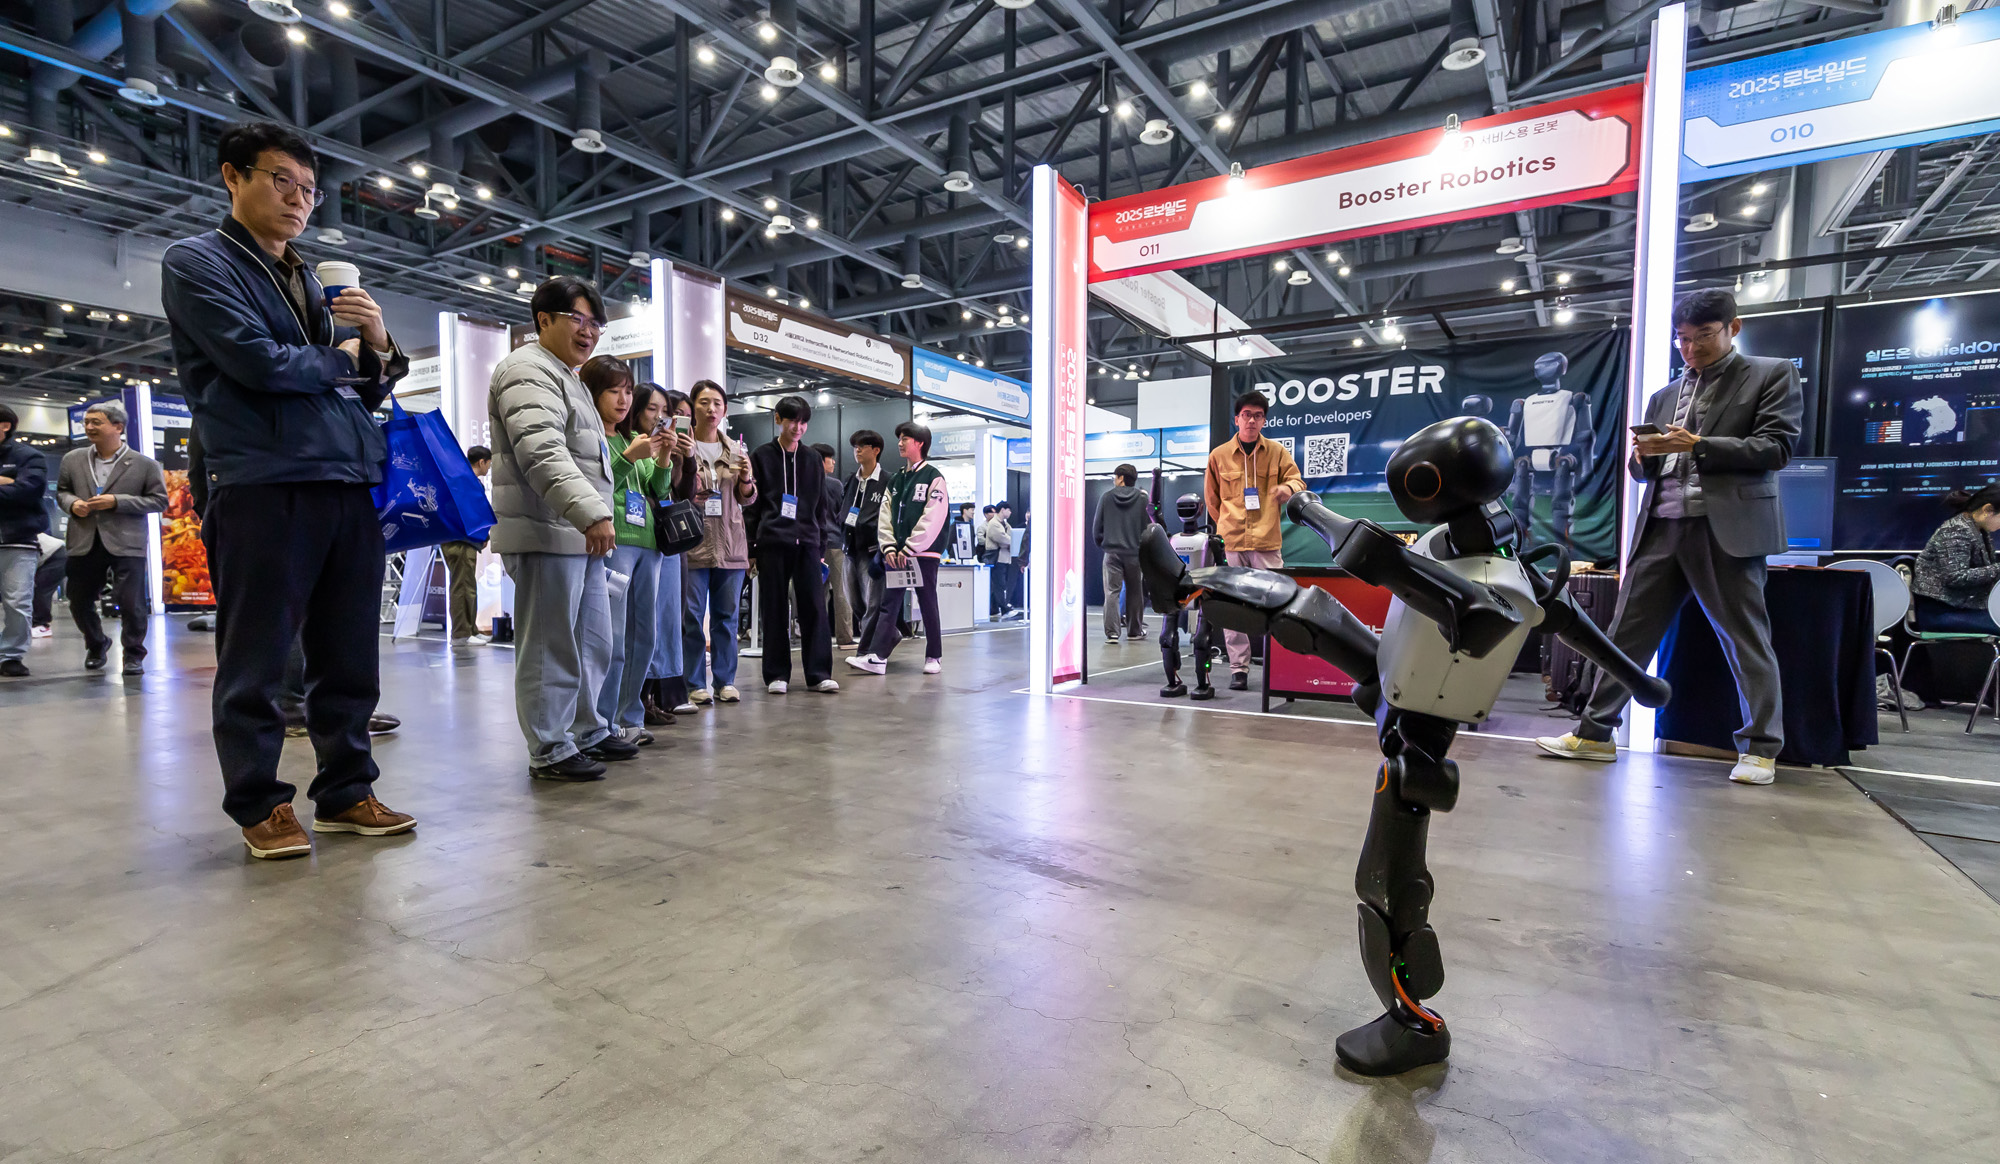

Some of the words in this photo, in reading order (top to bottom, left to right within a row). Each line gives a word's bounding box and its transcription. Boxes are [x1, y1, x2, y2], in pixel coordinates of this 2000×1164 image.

[1481, 125, 1529, 145] 서비스용
[1533, 119, 1559, 136] 로봇
[1337, 176, 1432, 212] Booster
[1439, 153, 1557, 191] Robotics
[753, 331, 769, 344] D32
[1254, 365, 1446, 408] BOOSTER
[1262, 415, 1283, 428] ade
[1286, 413, 1302, 427] for
[1305, 409, 1372, 427] Developers
[911, 483, 929, 502] H
